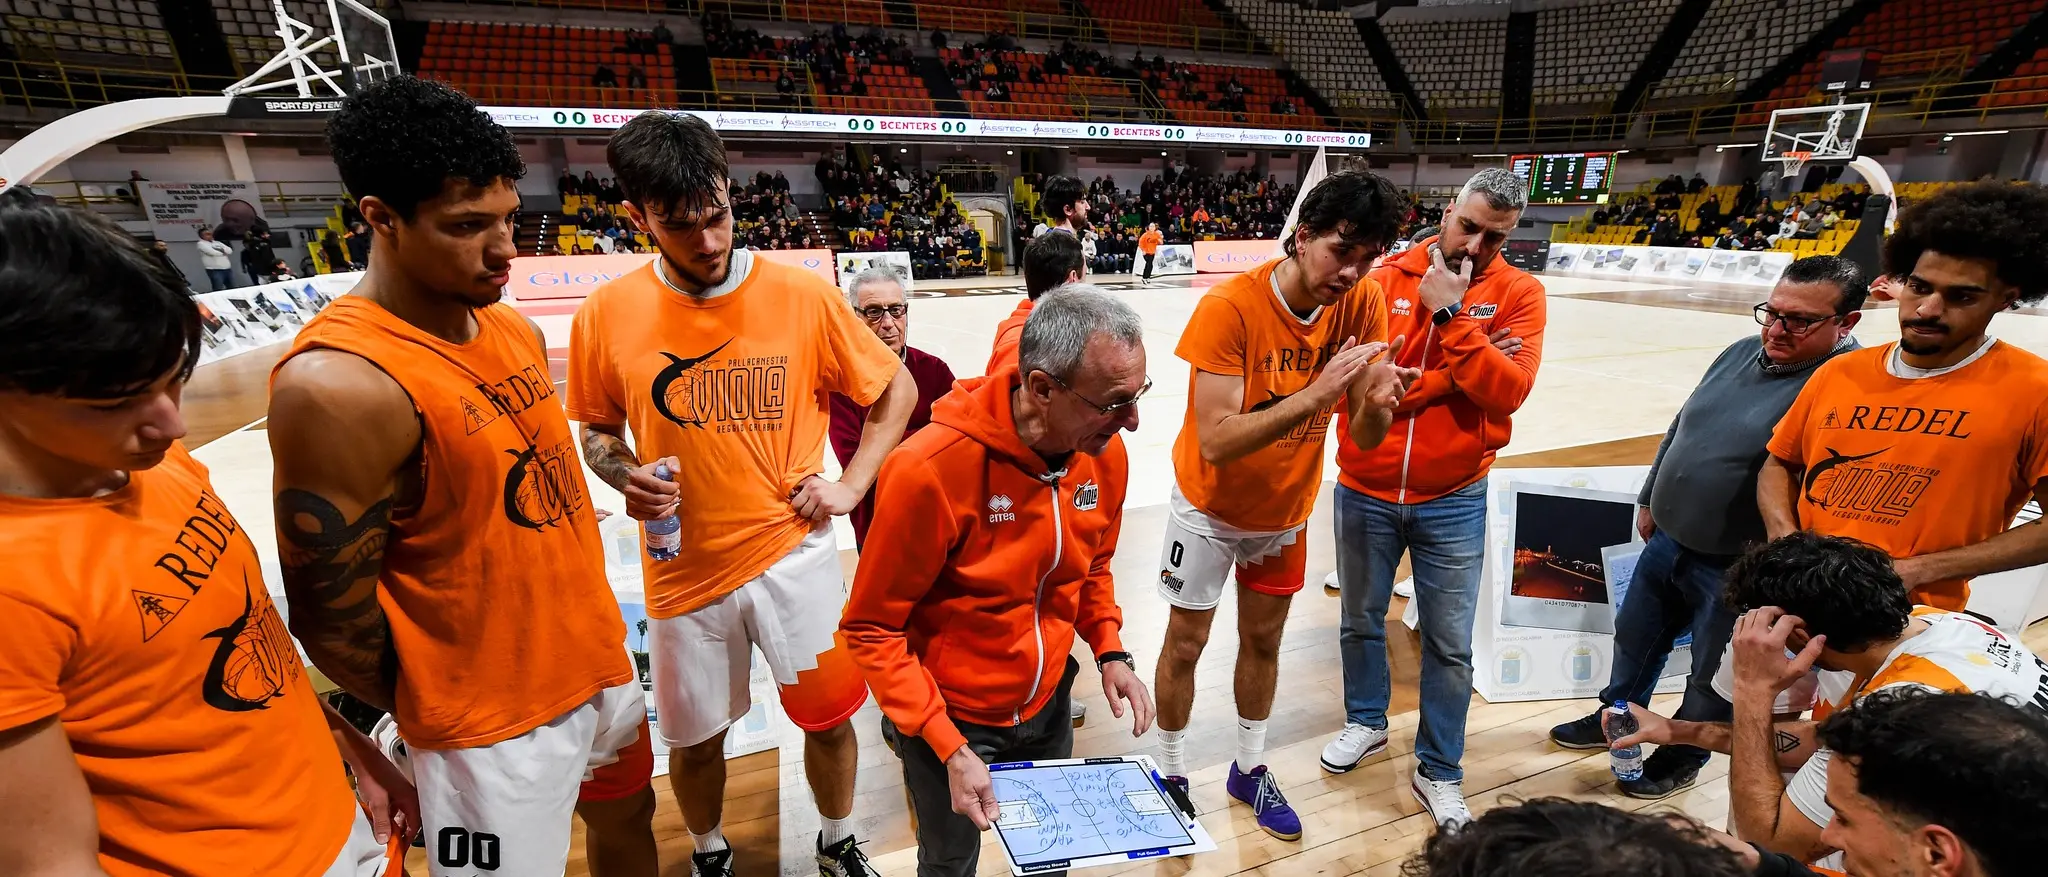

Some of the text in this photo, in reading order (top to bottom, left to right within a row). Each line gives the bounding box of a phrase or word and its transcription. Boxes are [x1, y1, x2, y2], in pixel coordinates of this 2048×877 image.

[880, 120, 937, 131] BCENTERS
[1113, 128, 1161, 137] BCENTERS
[1306, 135, 1345, 144] BCENTERS
[1474, 306, 1496, 317] VIOLA
[728, 355, 788, 368] PALLACANESTRO
[691, 366, 786, 424] VIOLA
[716, 422, 783, 434] REGGIO CALABRIA
[1846, 405, 1972, 440] REDEL
[1080, 488, 1098, 506] VIOLA
[1824, 467, 1932, 518] VIOLA
[1170, 540, 1185, 568] 0
[437, 826, 501, 871] 00
[1024, 863, 1051, 871] Coaching
